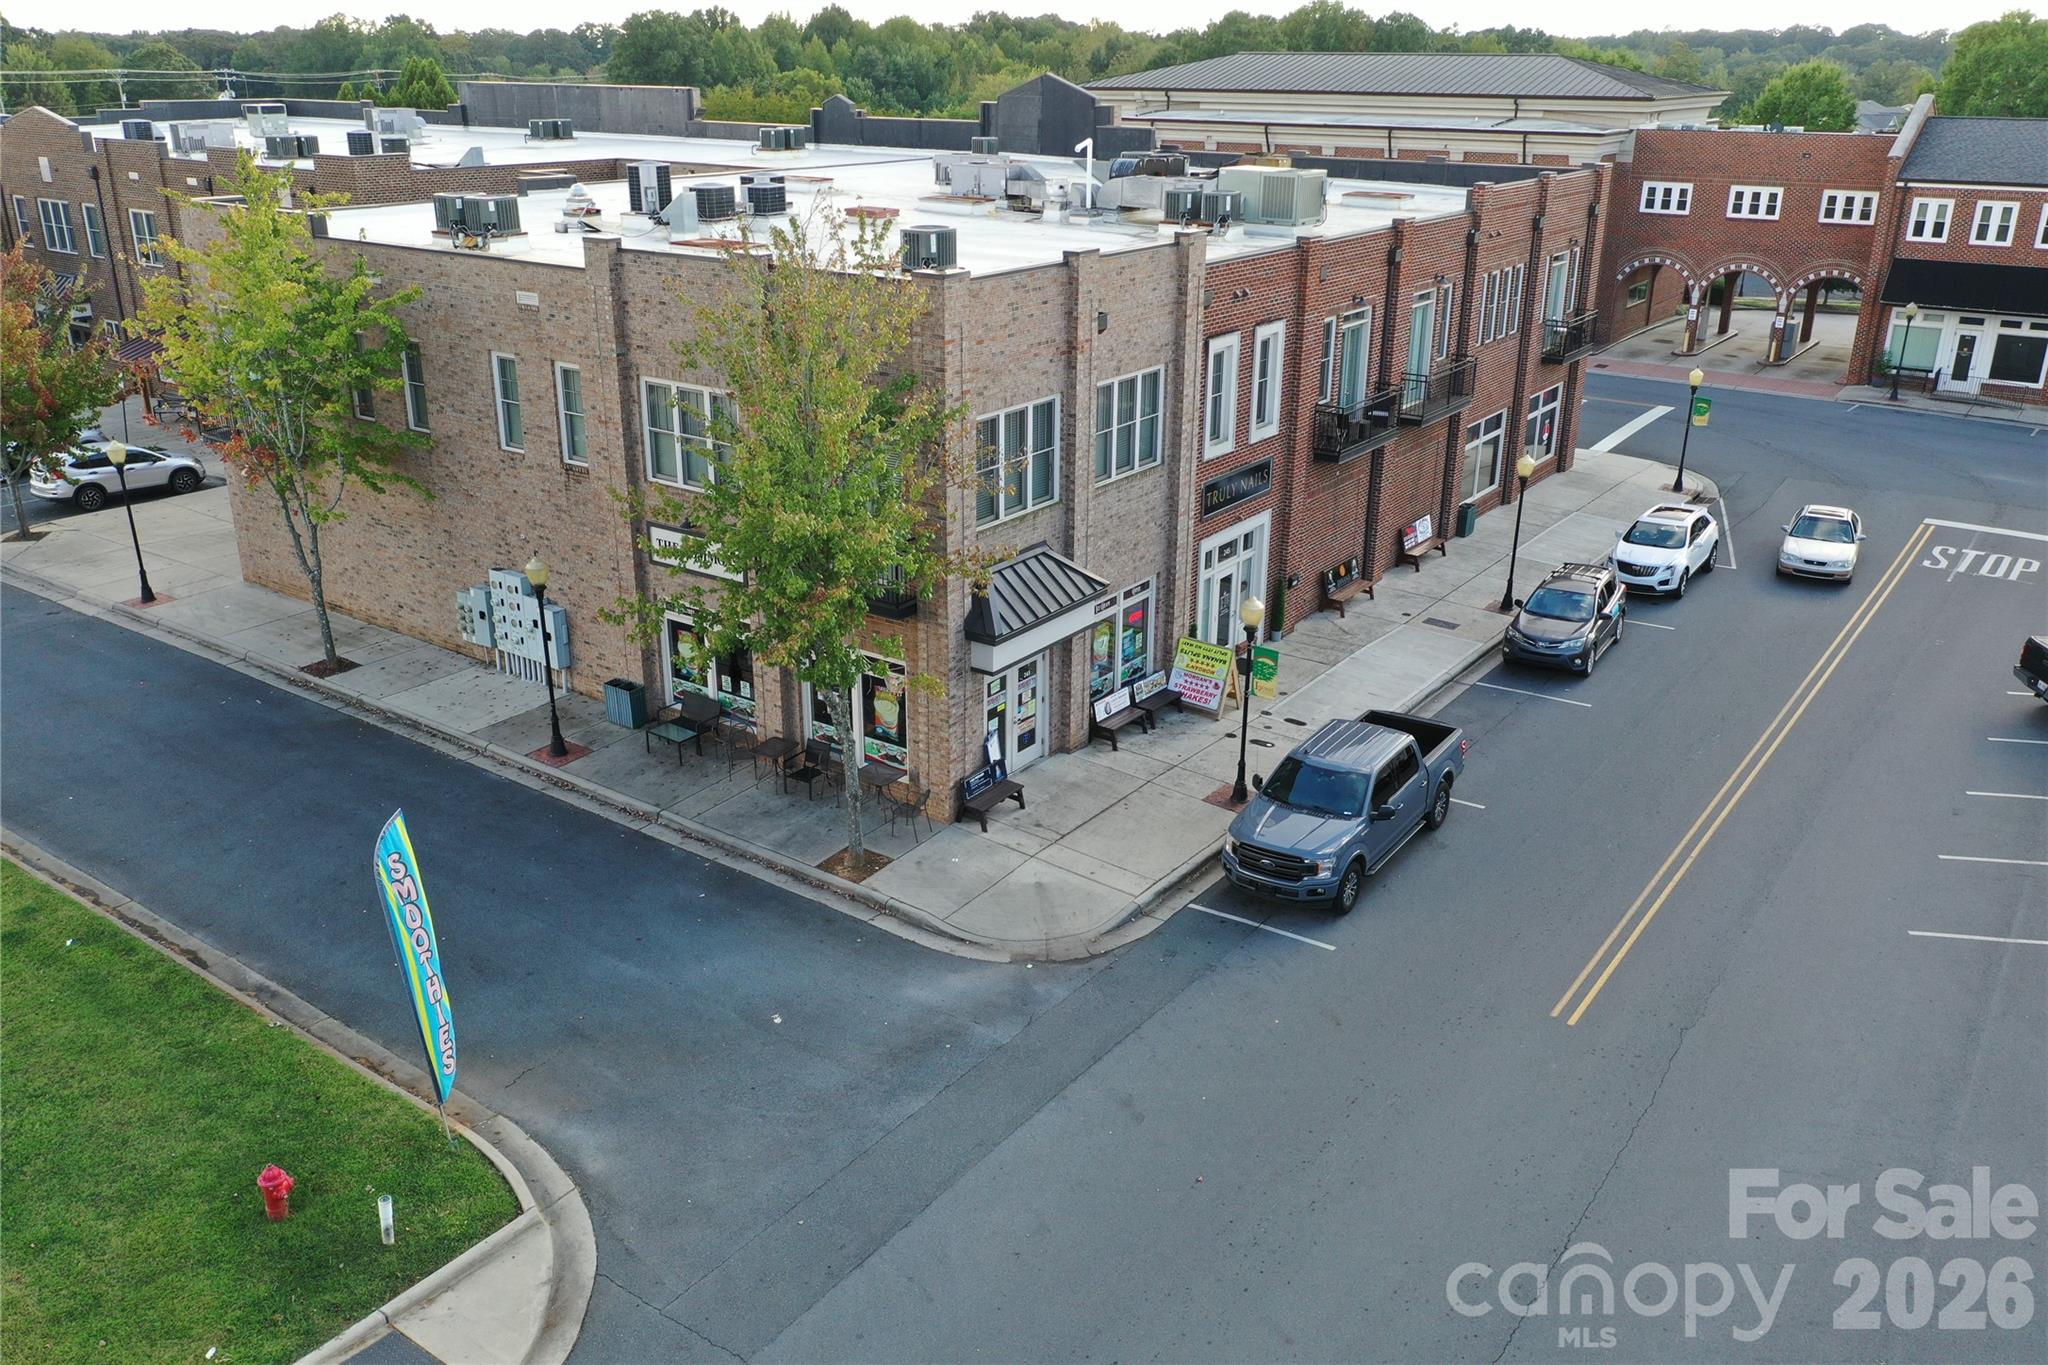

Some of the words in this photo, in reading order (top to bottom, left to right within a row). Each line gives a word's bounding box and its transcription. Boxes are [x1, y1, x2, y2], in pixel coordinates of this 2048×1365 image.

[1206, 481, 1237, 507] TRULY
[1240, 469, 1269, 494] NAILS
[1922, 545, 2040, 581] STOP
[1180, 648, 1201, 658] SPLITS
[1202, 654, 1227, 665] BANANA
[1173, 682, 1218, 699] STRAWBERRY
[387, 851, 457, 1076] SMOOTHIES
